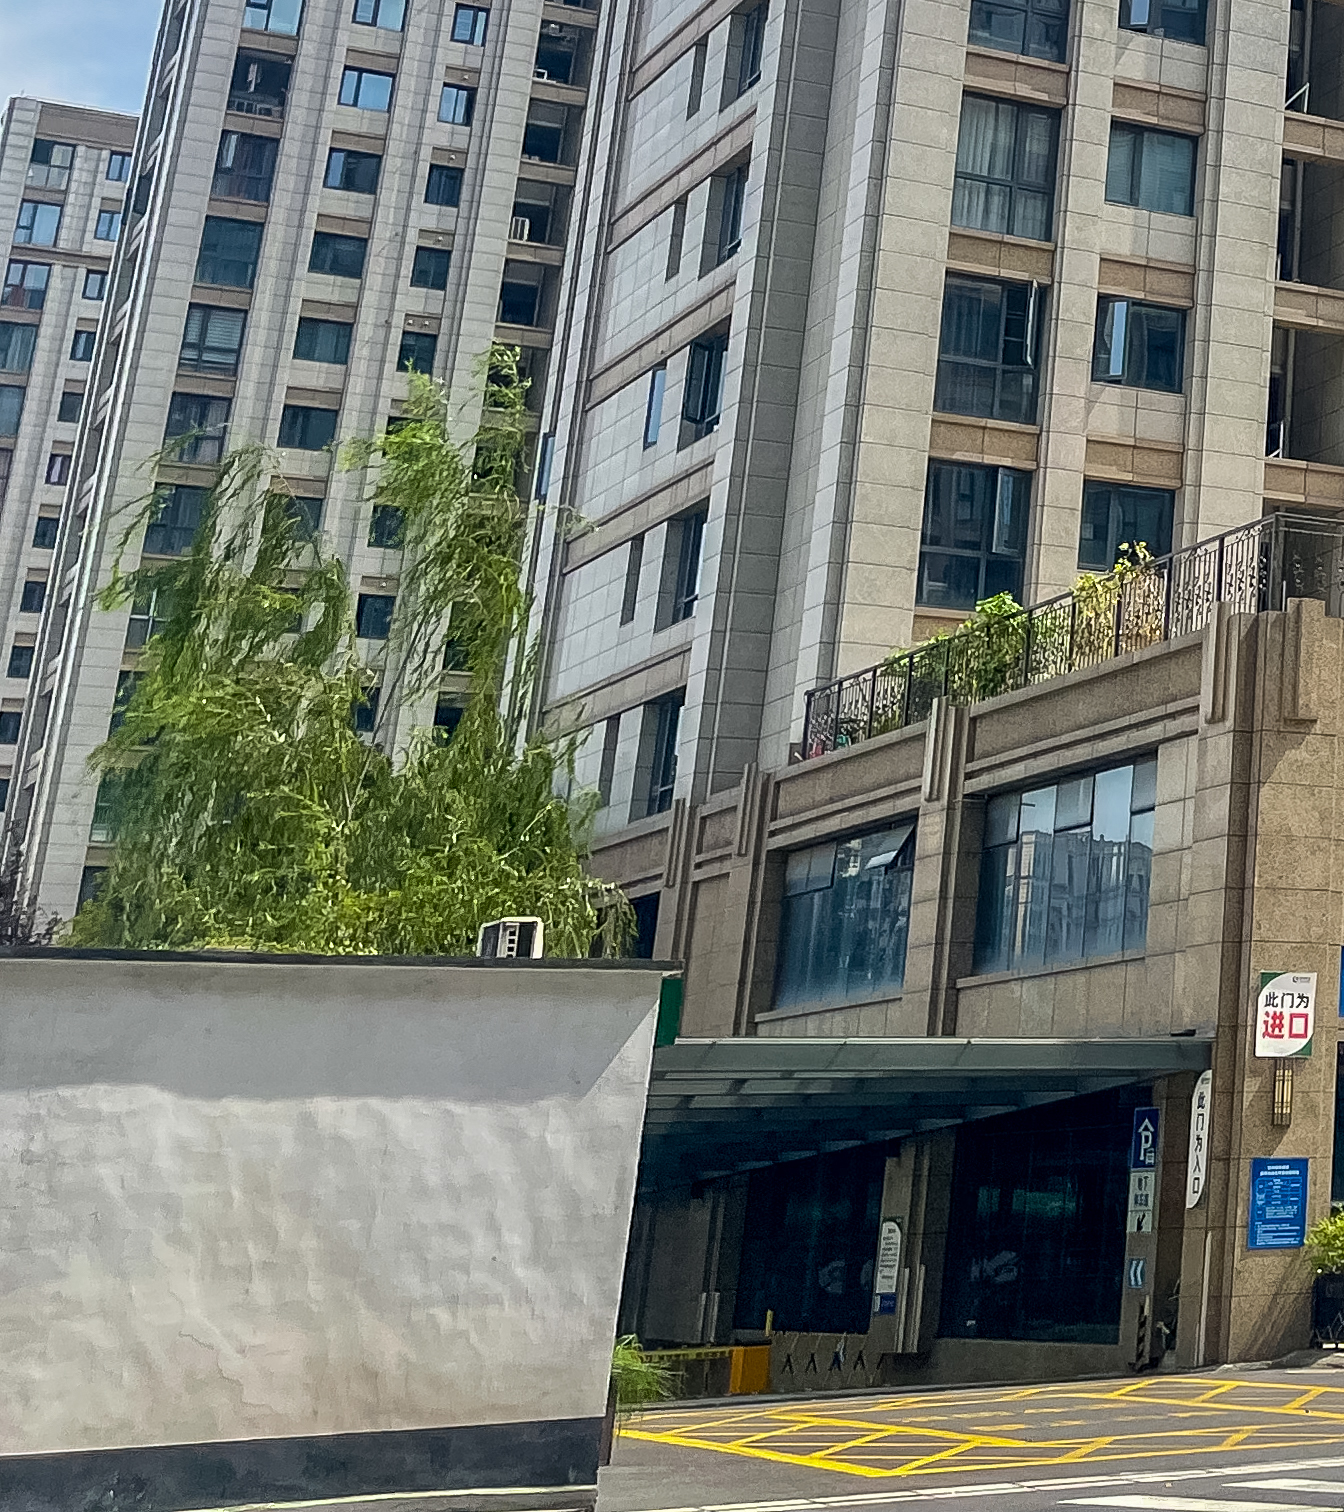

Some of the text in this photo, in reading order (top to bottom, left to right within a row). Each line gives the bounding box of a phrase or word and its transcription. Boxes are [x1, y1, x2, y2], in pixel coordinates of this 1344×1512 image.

[1264, 991, 1310, 1009] 此门为
[1262, 1011, 1309, 1039] 进口
